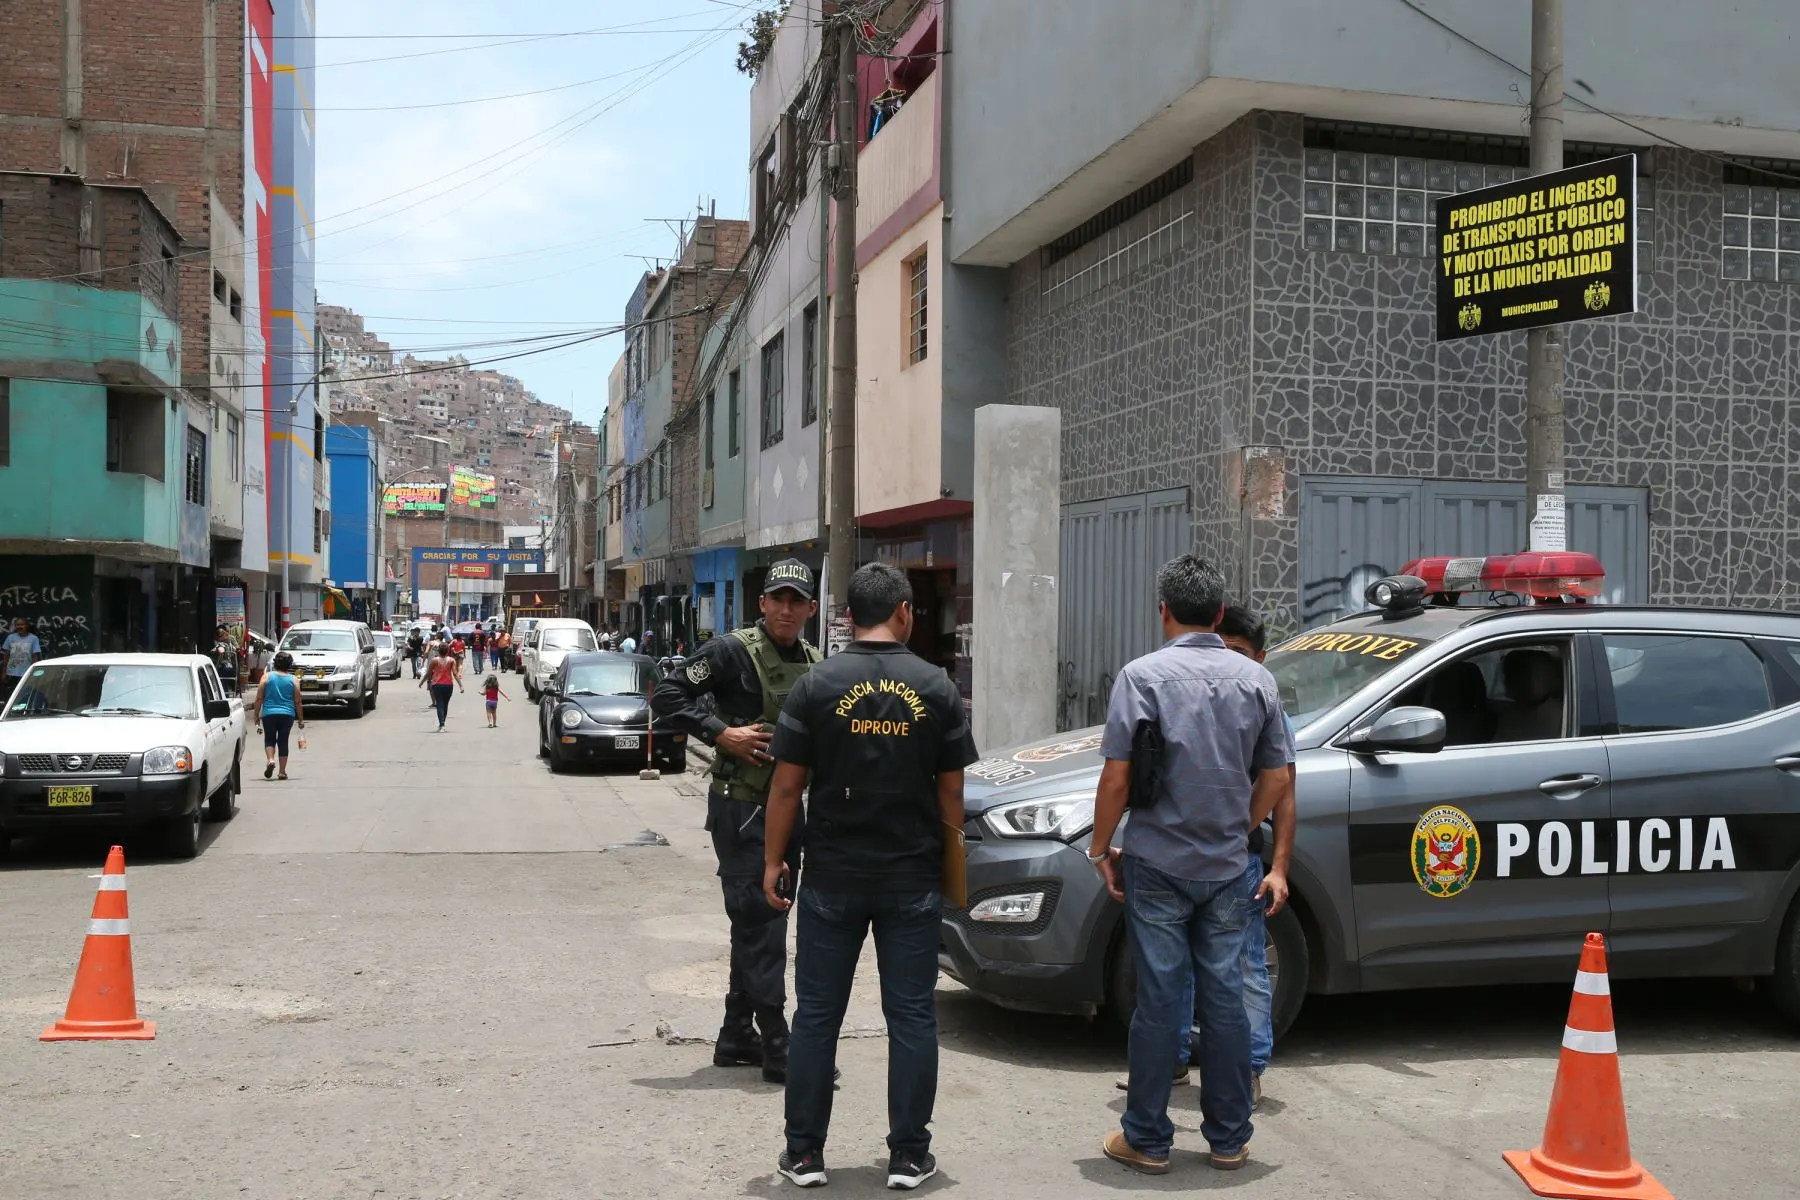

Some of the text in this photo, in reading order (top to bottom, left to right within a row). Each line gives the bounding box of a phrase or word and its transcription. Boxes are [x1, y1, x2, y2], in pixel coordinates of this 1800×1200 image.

[1450, 174, 1617, 230] PROHIBIDO EL INGRESO
[1443, 198, 1625, 254] DE TRANSPORTE PÚBLICO
[1443, 223, 1625, 276] Y MOTOTAXIS POR ORDEN
[1454, 251, 1612, 298] DE LA MUNICIPALIDAD
[1501, 299, 1559, 317] MUNICIPALIDAD
[423, 552, 532, 561] GRACIAS POR SU VISITA
[770, 564, 808, 583] POLICIA
[1273, 633, 1419, 660] DIPROVE
[836, 679, 927, 722] POLICIA NACIONAL
[851, 719, 909, 737] DIPROVE
[50, 791, 91, 804] F6R-826
[1420, 809, 1472, 830] POLICIA NACIONAL
[1496, 817, 1737, 878] POLICIA
